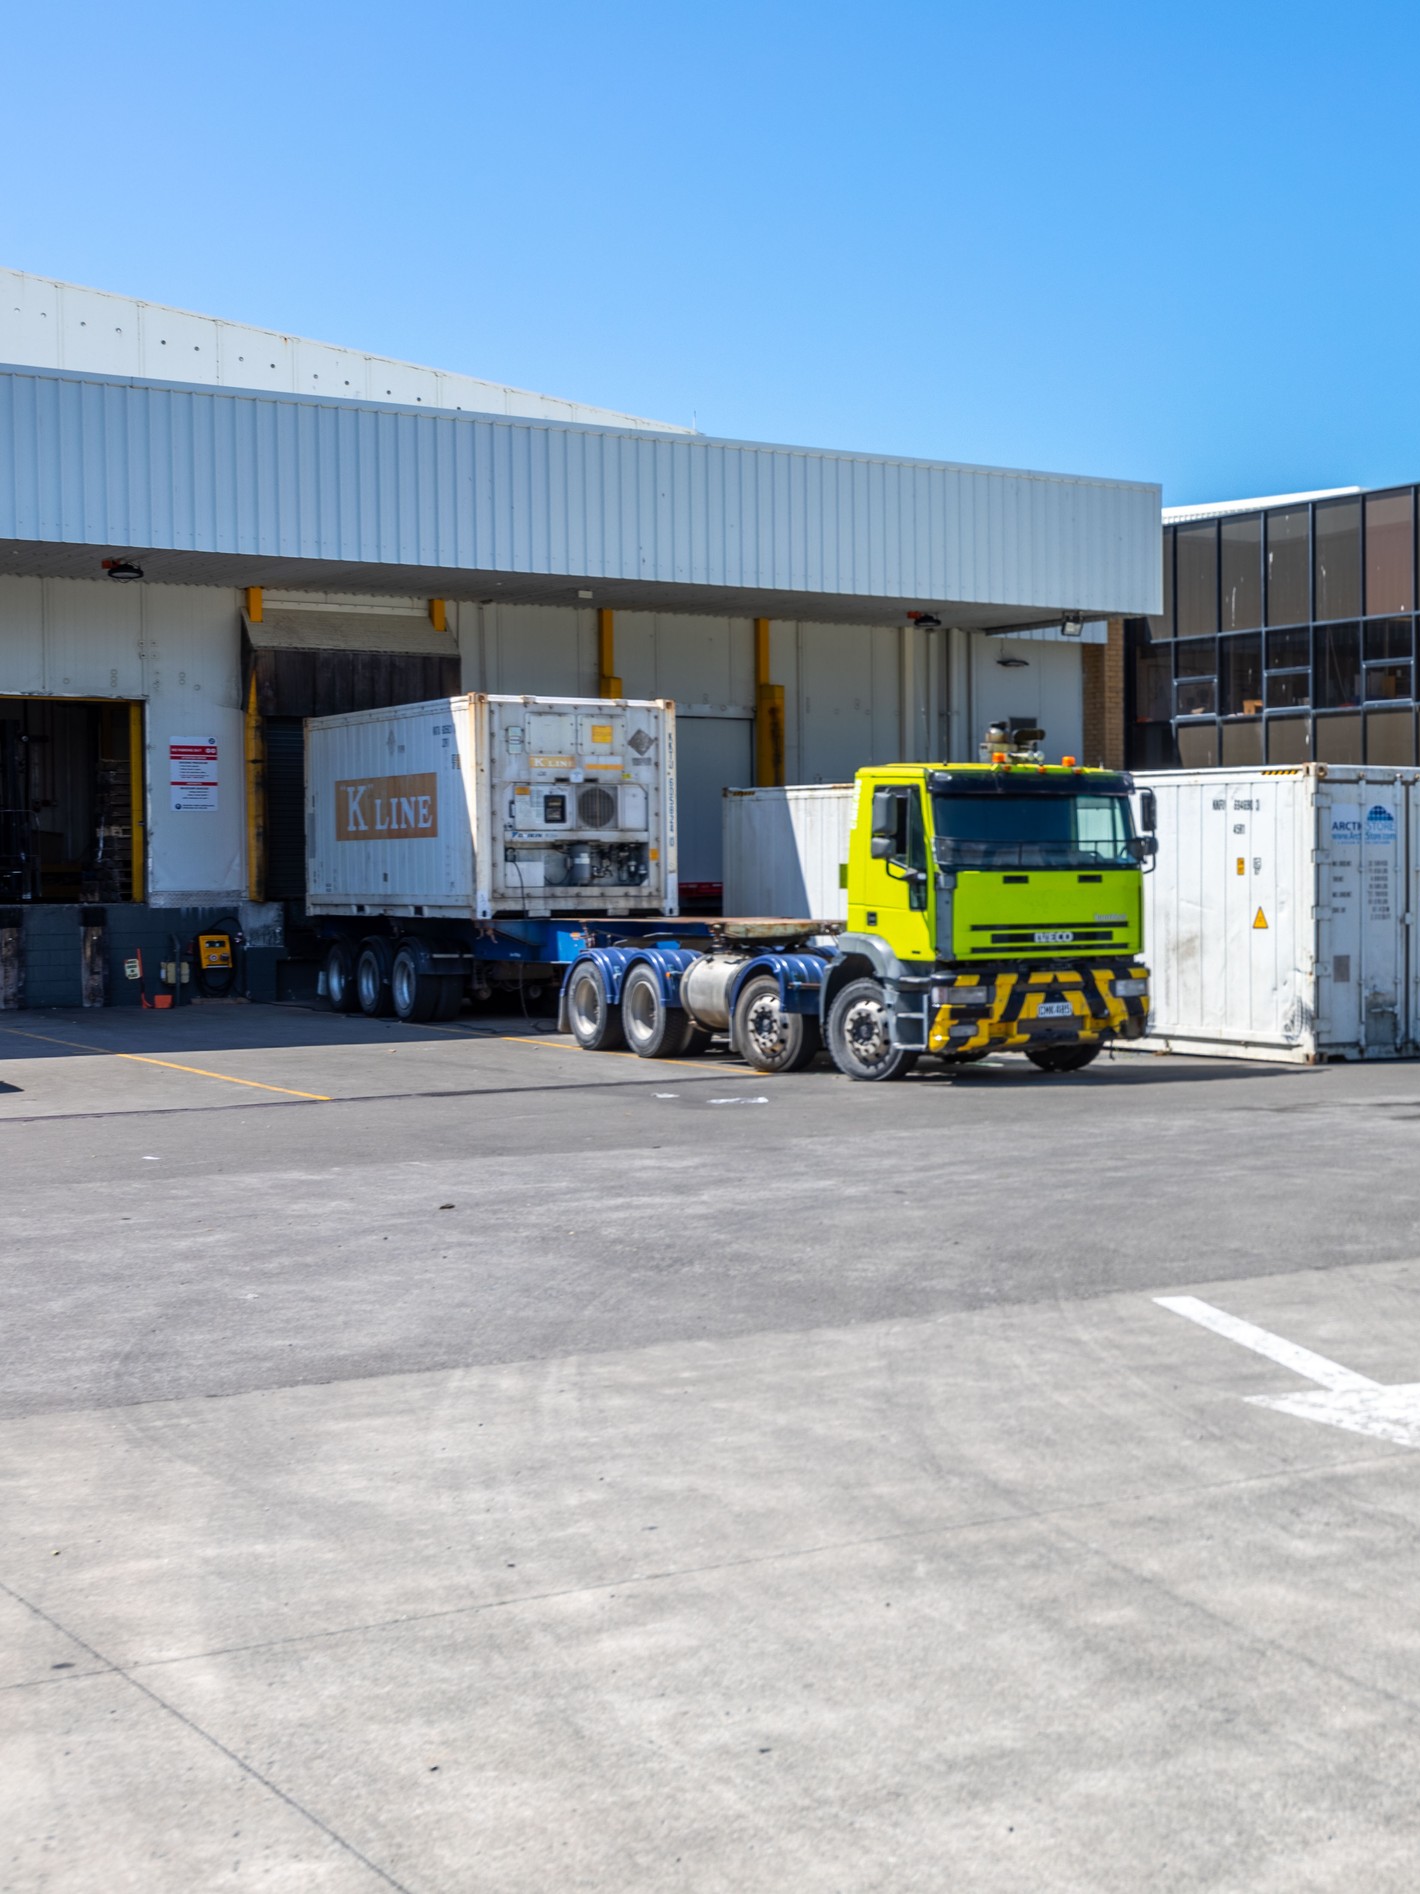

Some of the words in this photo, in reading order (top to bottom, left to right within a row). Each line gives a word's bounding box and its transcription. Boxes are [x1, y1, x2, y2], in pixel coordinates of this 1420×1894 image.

[374, 796, 432, 830] LINE
[1367, 821, 1394, 832] STORE
[1034, 932, 1074, 942] IVECO
